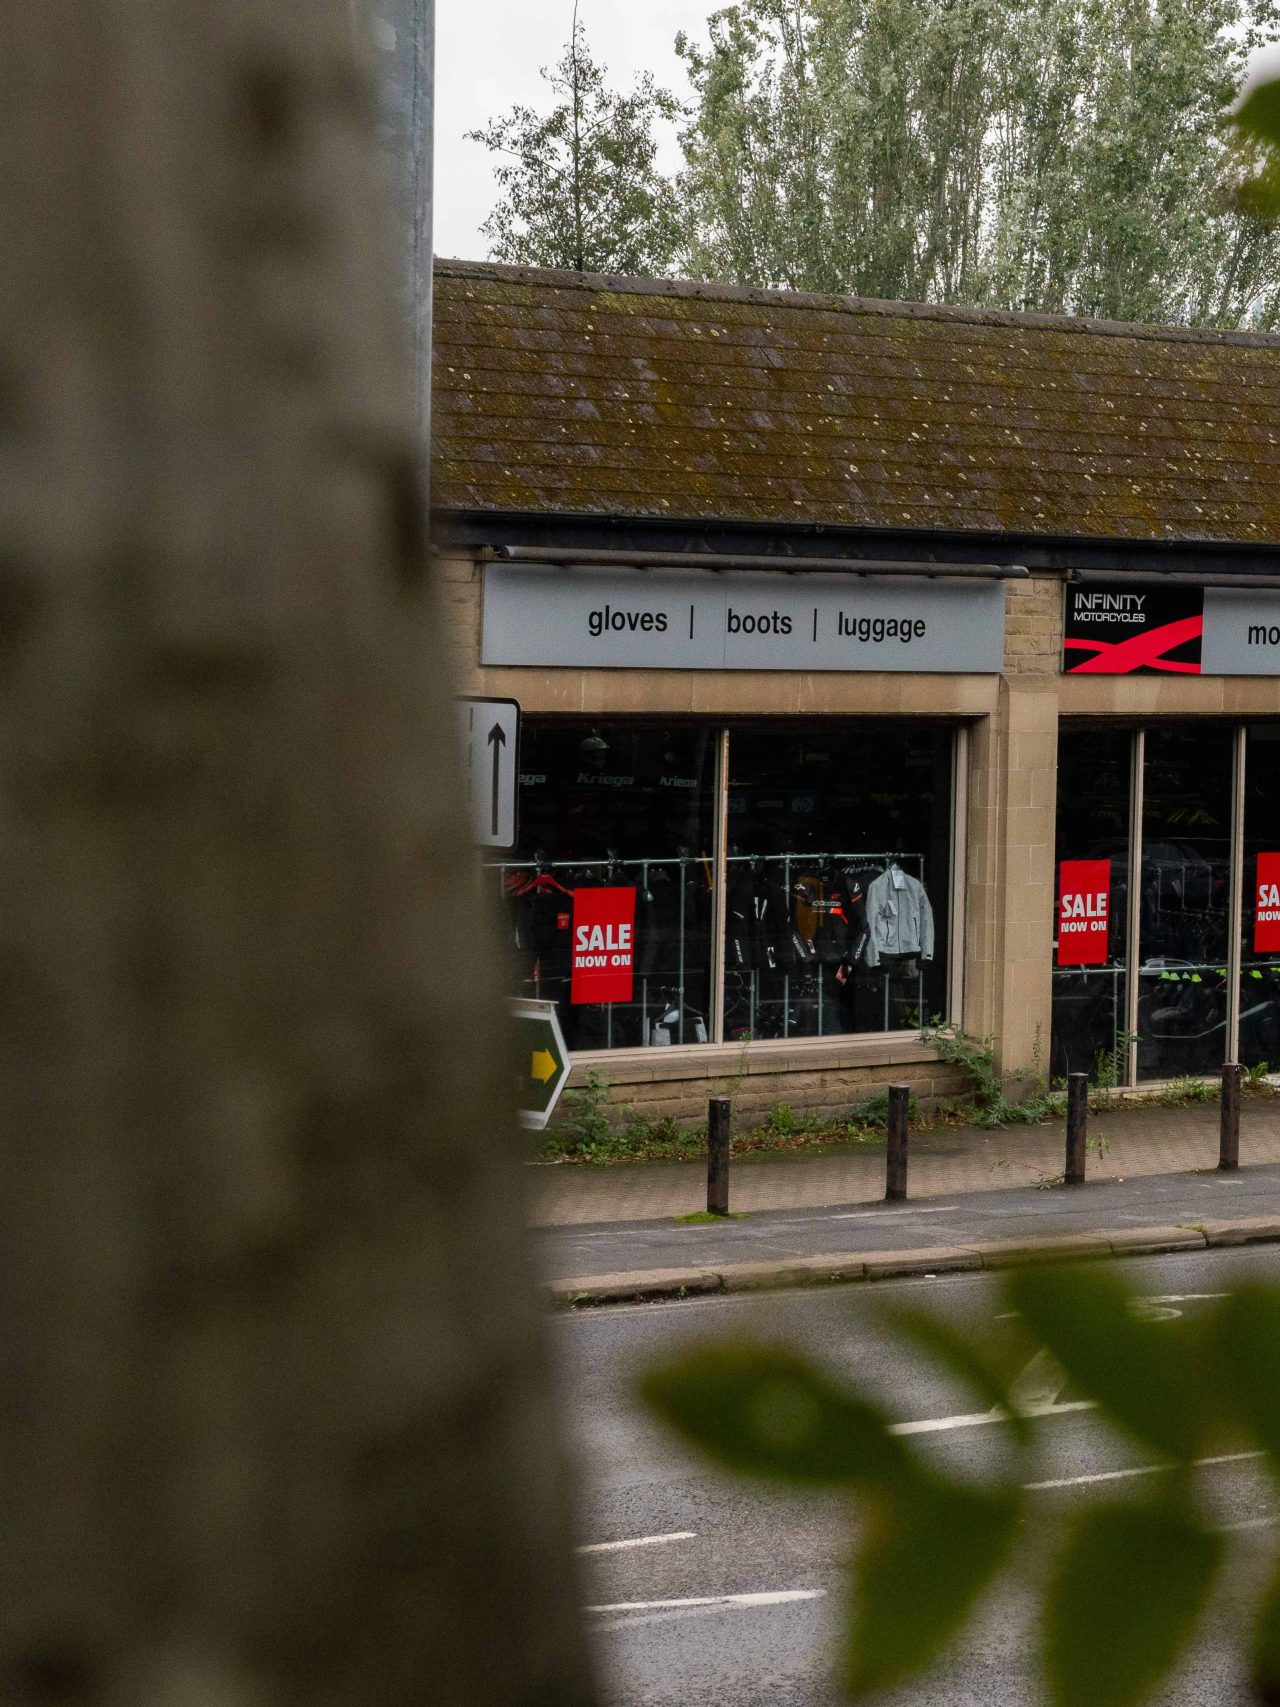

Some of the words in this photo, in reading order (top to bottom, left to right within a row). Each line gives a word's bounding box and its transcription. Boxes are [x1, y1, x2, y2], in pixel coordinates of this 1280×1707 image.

[1075, 592, 1146, 610] INFINITY
[588, 605, 668, 636] gloves
[727, 608, 793, 635] boots
[838, 611, 926, 644] luggage
[1073, 611, 1146, 623] MOTORCYCLES
[518, 774, 547, 786] ega
[576, 772, 634, 788] Kriega
[1061, 893, 1107, 918] SALE
[1060, 921, 1087, 933] NOW
[1090, 920, 1107, 931] ON
[575, 923, 632, 952] SALE
[575, 955, 608, 968] NOW
[611, 954, 632, 966] ON
